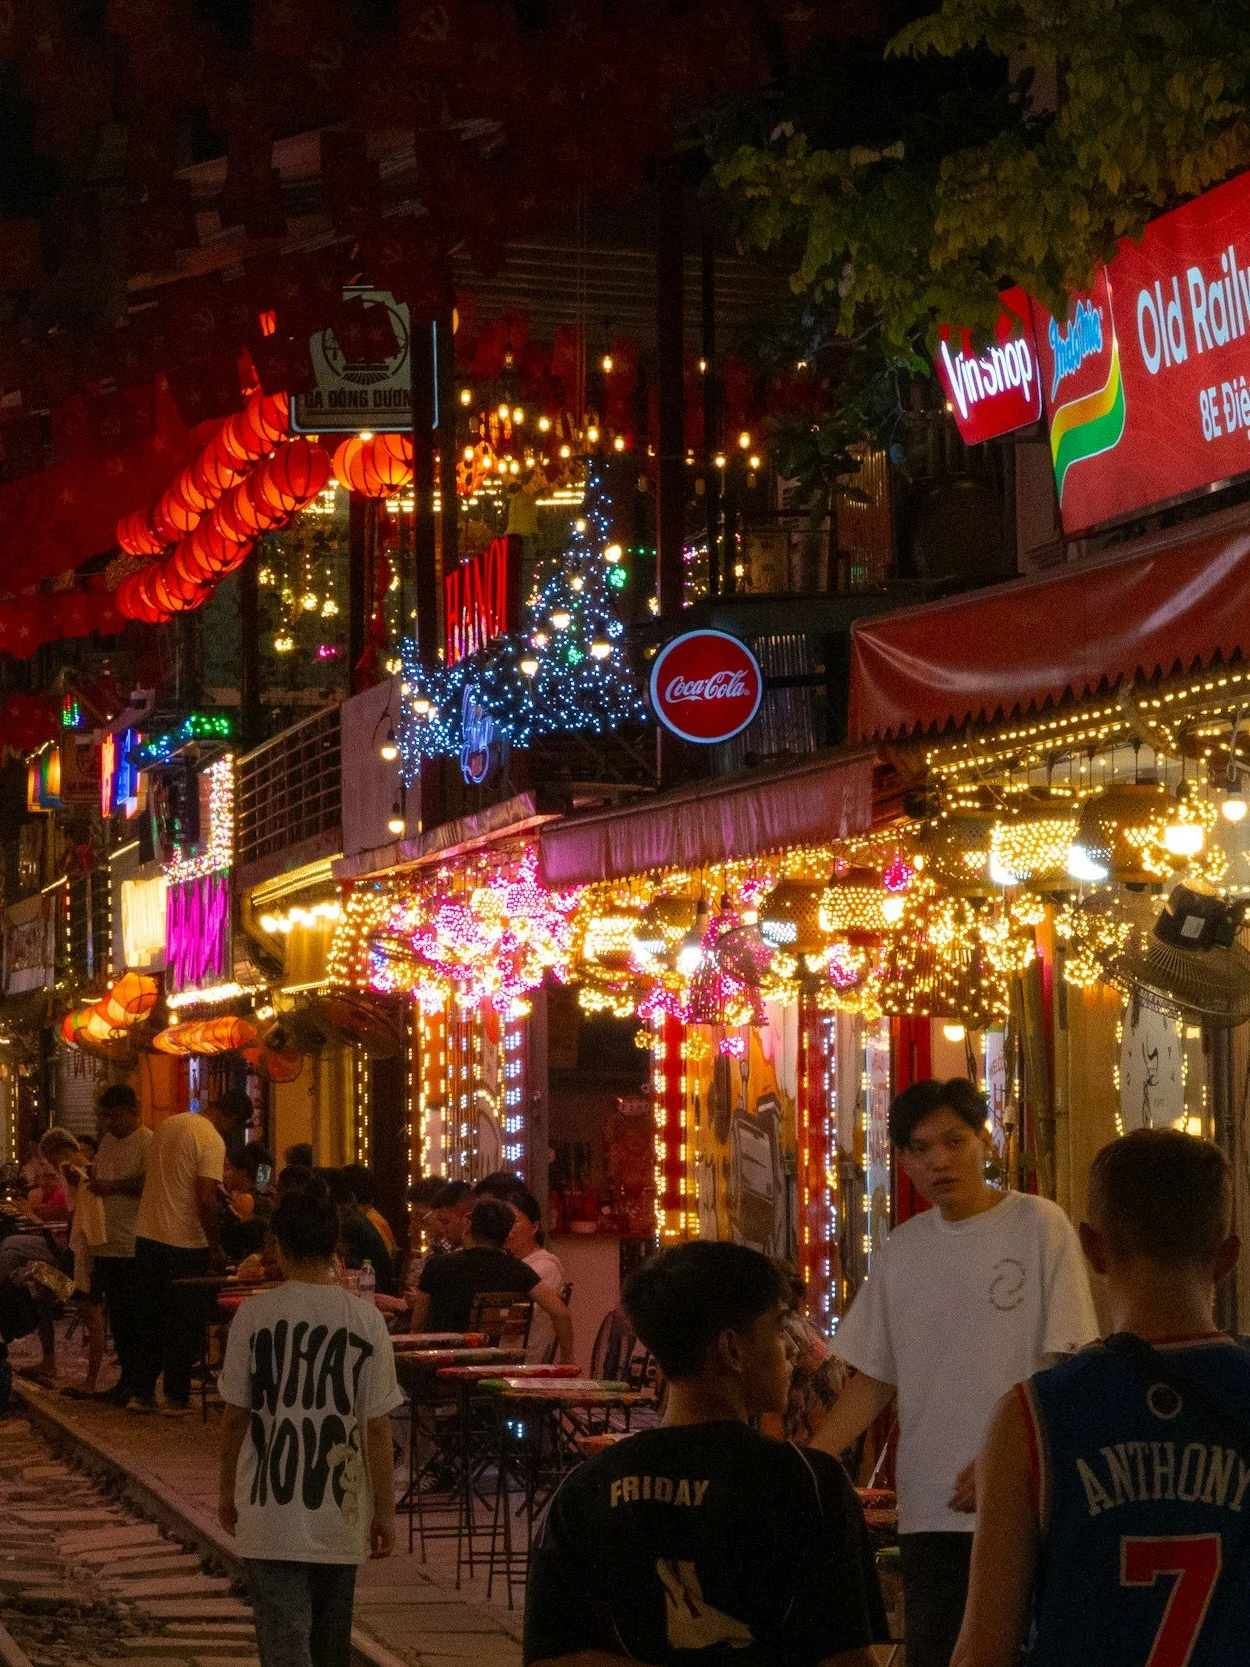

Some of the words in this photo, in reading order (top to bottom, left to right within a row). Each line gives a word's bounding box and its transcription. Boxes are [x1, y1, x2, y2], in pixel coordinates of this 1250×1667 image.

[1136, 275, 1189, 375] Old
[1199, 386, 1223, 441] 8E
[665, 670, 748, 704] Coca-Cola
[250, 1319, 374, 1417] WHAT
[609, 1475, 710, 1510] FRIDAY
[1075, 1440, 1250, 1517] ANTHONY
[1118, 1532, 1223, 1667] 7
